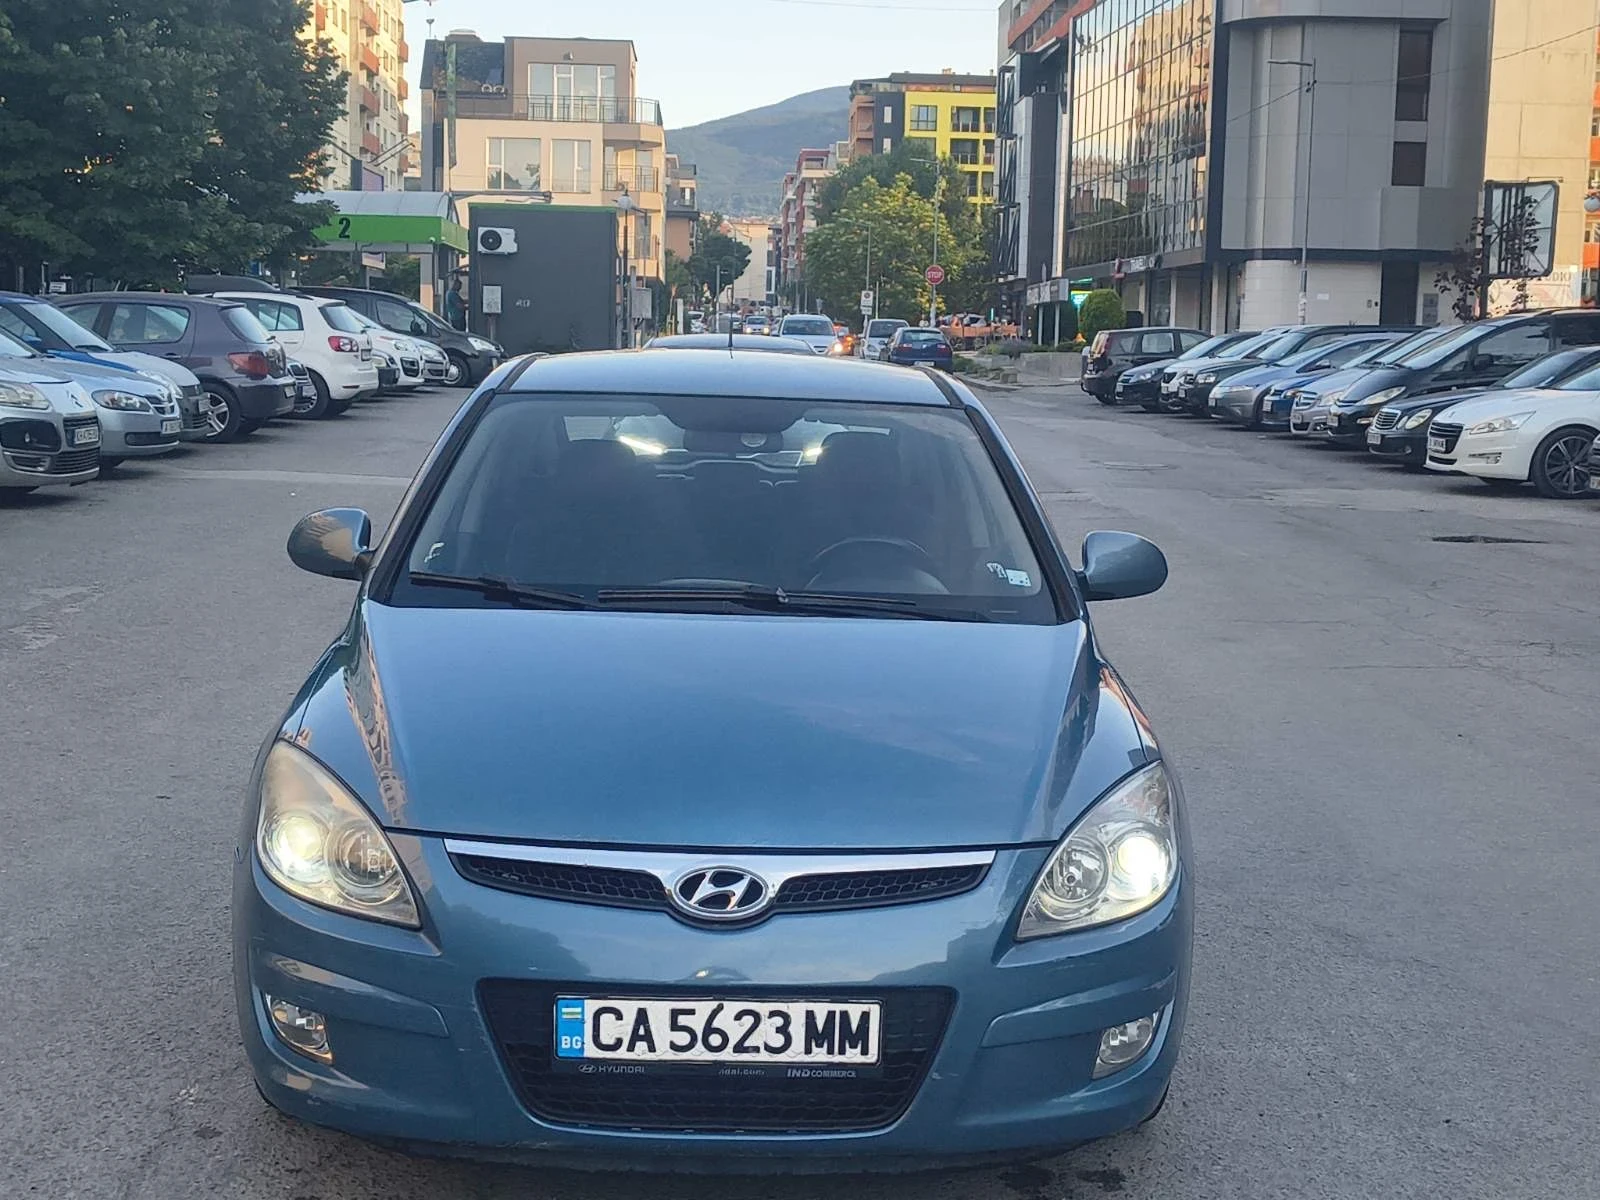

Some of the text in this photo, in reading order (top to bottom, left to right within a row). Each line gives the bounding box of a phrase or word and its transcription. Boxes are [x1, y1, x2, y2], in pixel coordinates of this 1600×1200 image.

[338, 217, 351, 239] 2
[927, 271, 942, 279] STOP
[591, 1003, 871, 1056] CA 5623 MM
[561, 1035, 582, 1049] BG
[598, 1065, 645, 1073] HYUNDAI
